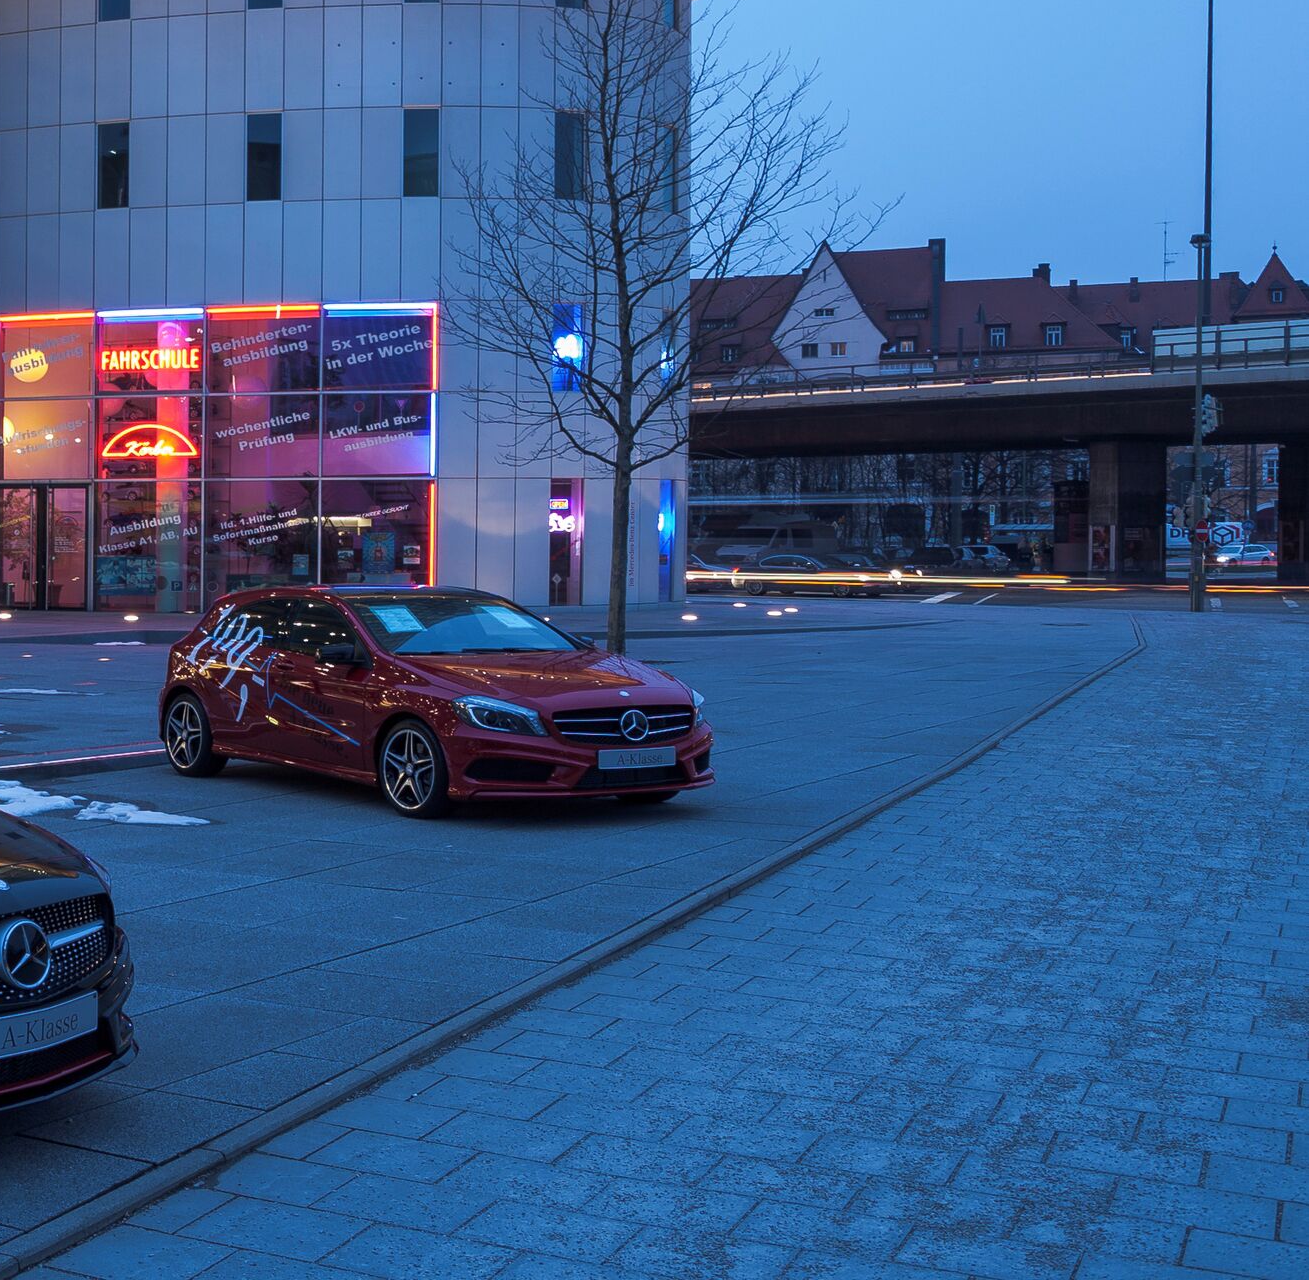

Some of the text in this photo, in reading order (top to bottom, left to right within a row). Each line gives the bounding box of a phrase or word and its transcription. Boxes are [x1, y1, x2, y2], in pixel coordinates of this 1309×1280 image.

[211, 323, 312, 354] Behinderten-
[331, 324, 421, 352] 5x Theorie
[101, 348, 199, 370] FAHRSCHULE
[223, 340, 308, 367] ausbildung
[325, 339, 434, 370] in der Woche
[215, 411, 310, 439] wöchentliche
[329, 413, 422, 440] LKW- und Bus-
[239, 432, 295, 452] Prüfung
[344, 430, 414, 452] ausbildung
[278, 508, 297, 519] und
[110, 515, 181, 536] Ausbildung
[99, 540, 136, 554] Klasse
[248, 534, 279, 546] Kurse
[617, 752, 663, 766] A-Klasse
[1, 1013, 78, 1049] A-Klasse
